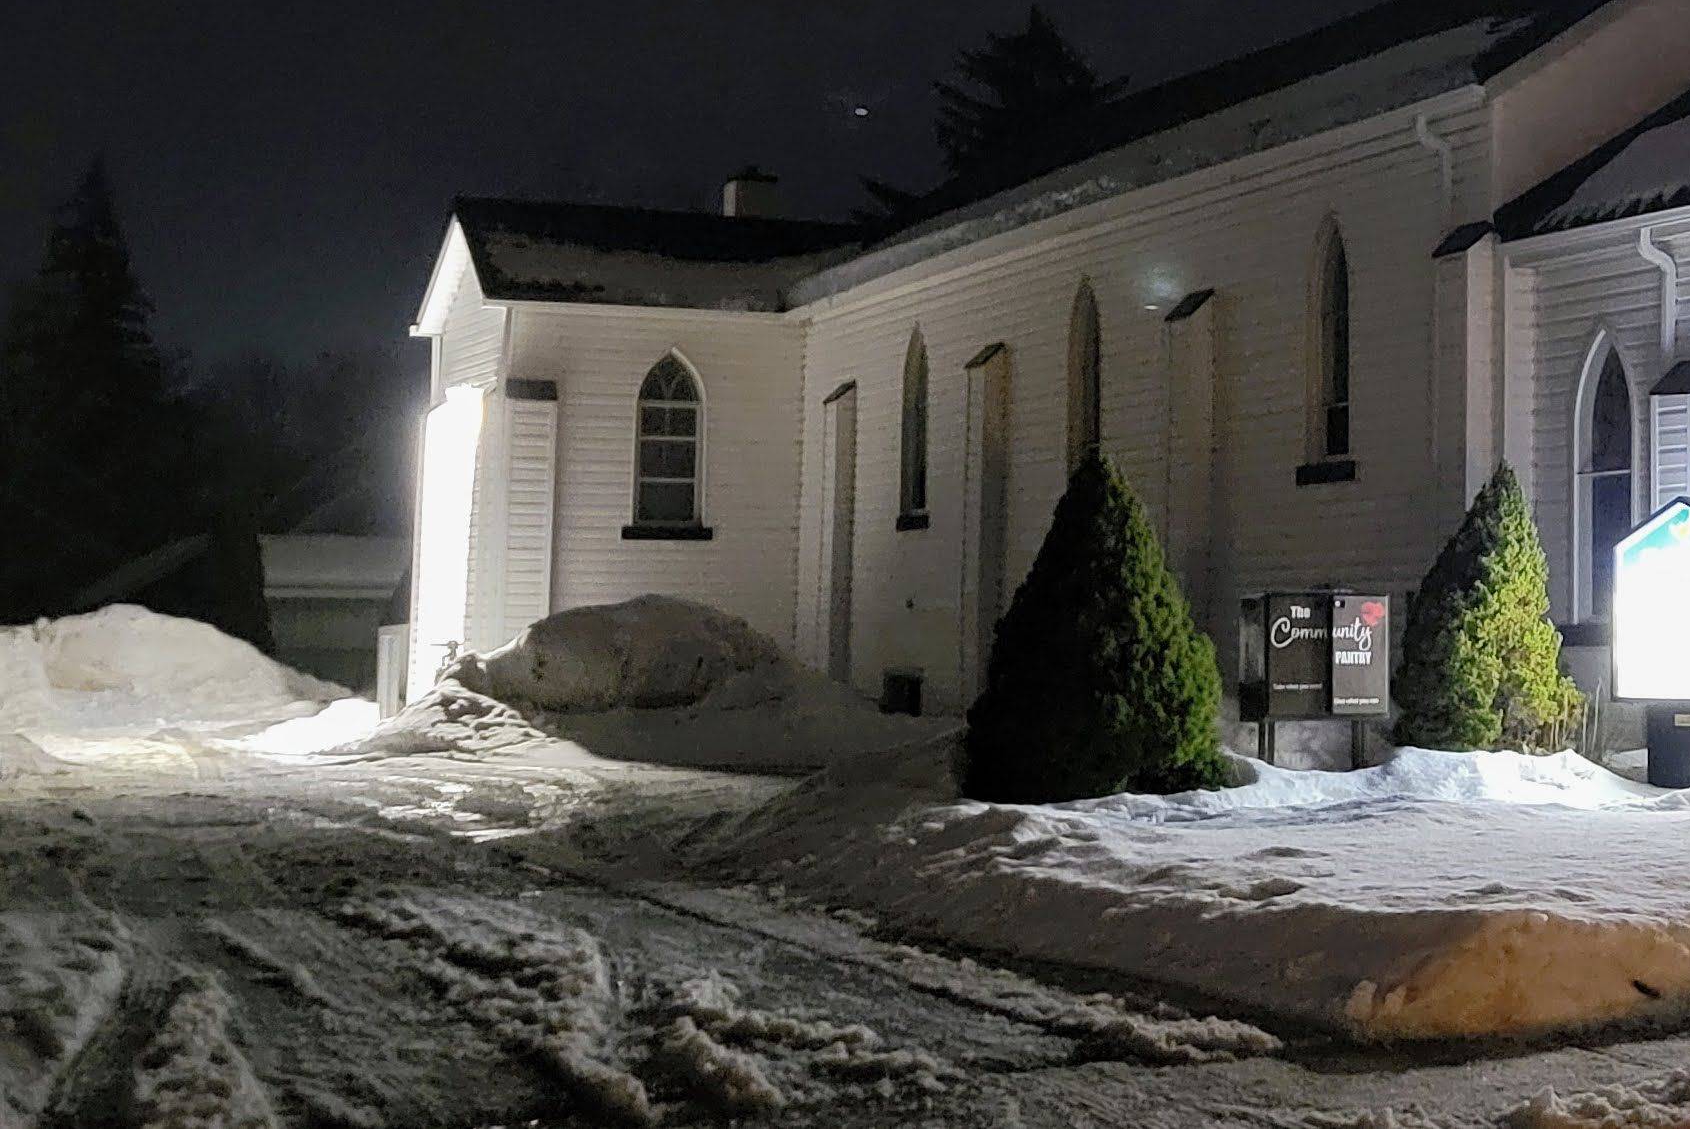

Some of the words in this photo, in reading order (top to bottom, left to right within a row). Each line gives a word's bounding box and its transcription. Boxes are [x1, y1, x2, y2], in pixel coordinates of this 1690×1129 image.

[1290, 606, 1311, 619] The
[1271, 617, 1372, 651] Community
[1335, 651, 1372, 665] PANTRY
